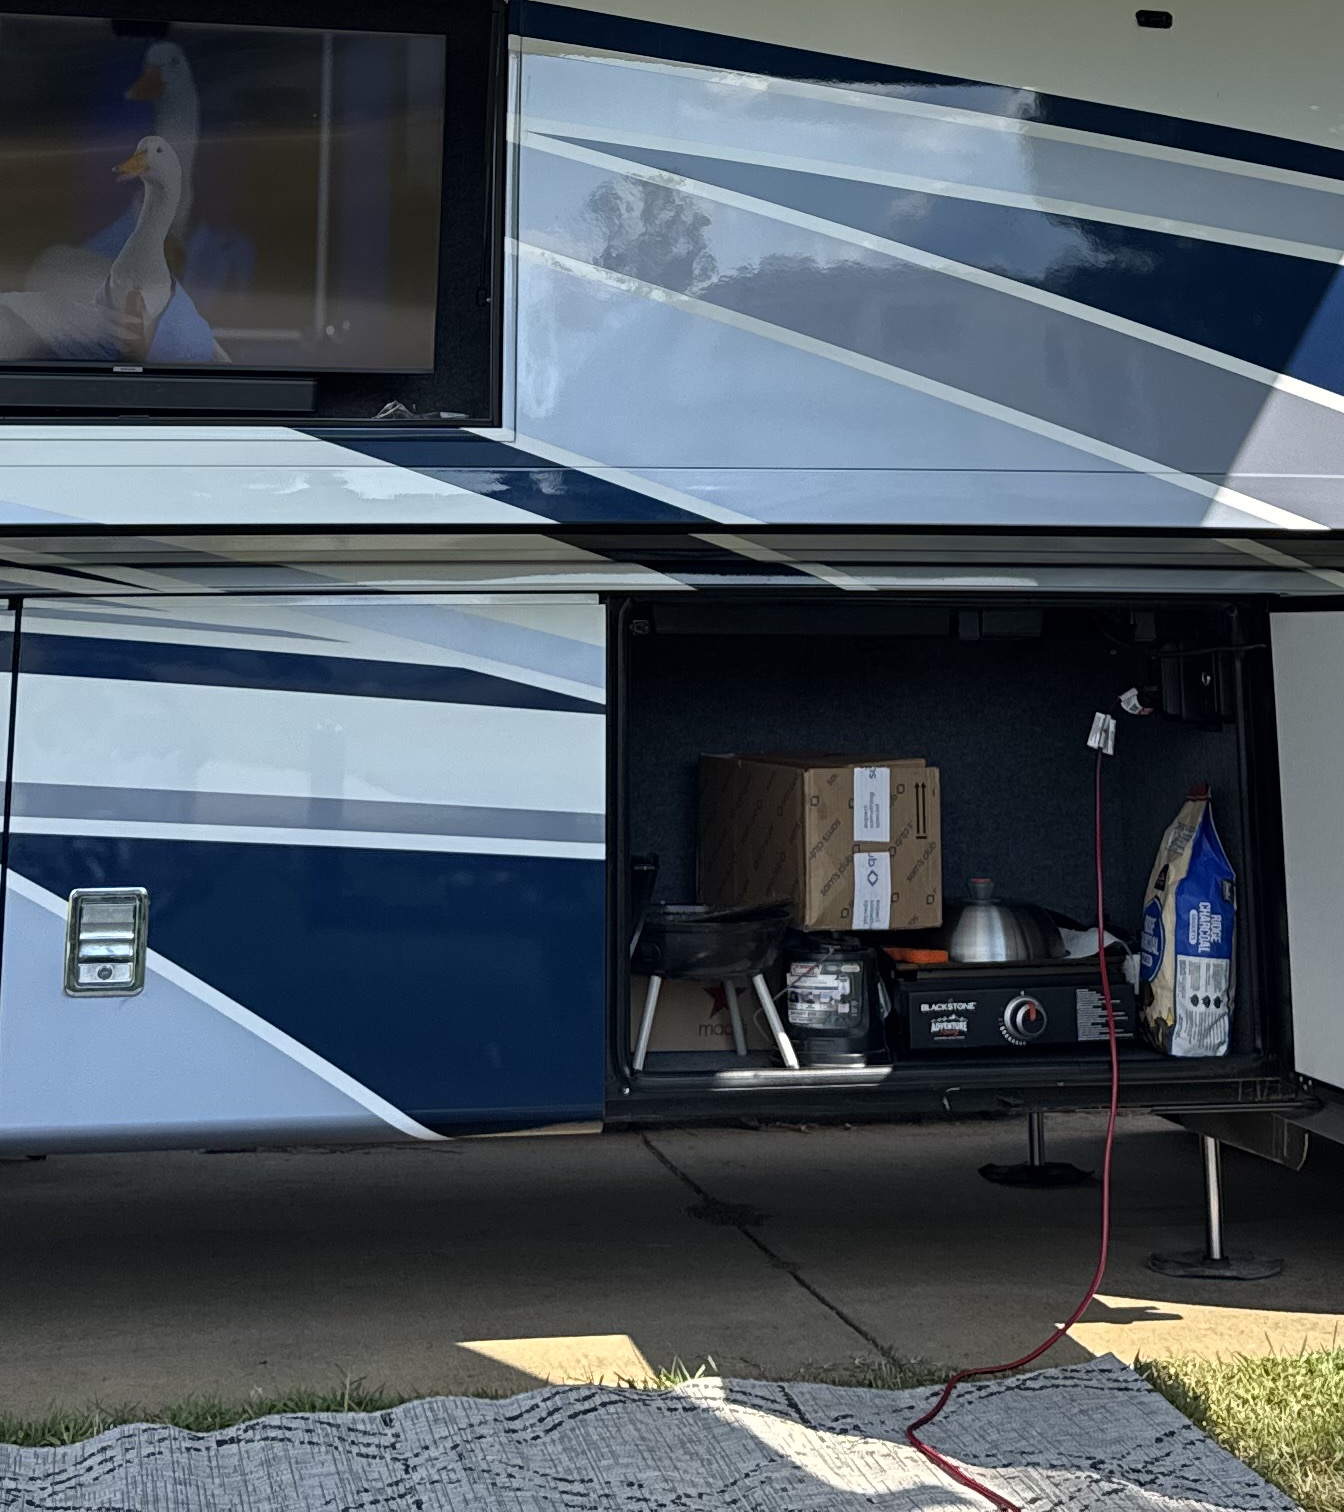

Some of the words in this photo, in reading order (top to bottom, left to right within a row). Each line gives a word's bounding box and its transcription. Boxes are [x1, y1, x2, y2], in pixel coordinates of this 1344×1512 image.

[1197, 901, 1212, 954] CHARCOAL
[920, 1001, 977, 1013] BLACKSTONE
[930, 1021, 968, 1033] ADVENTURE
